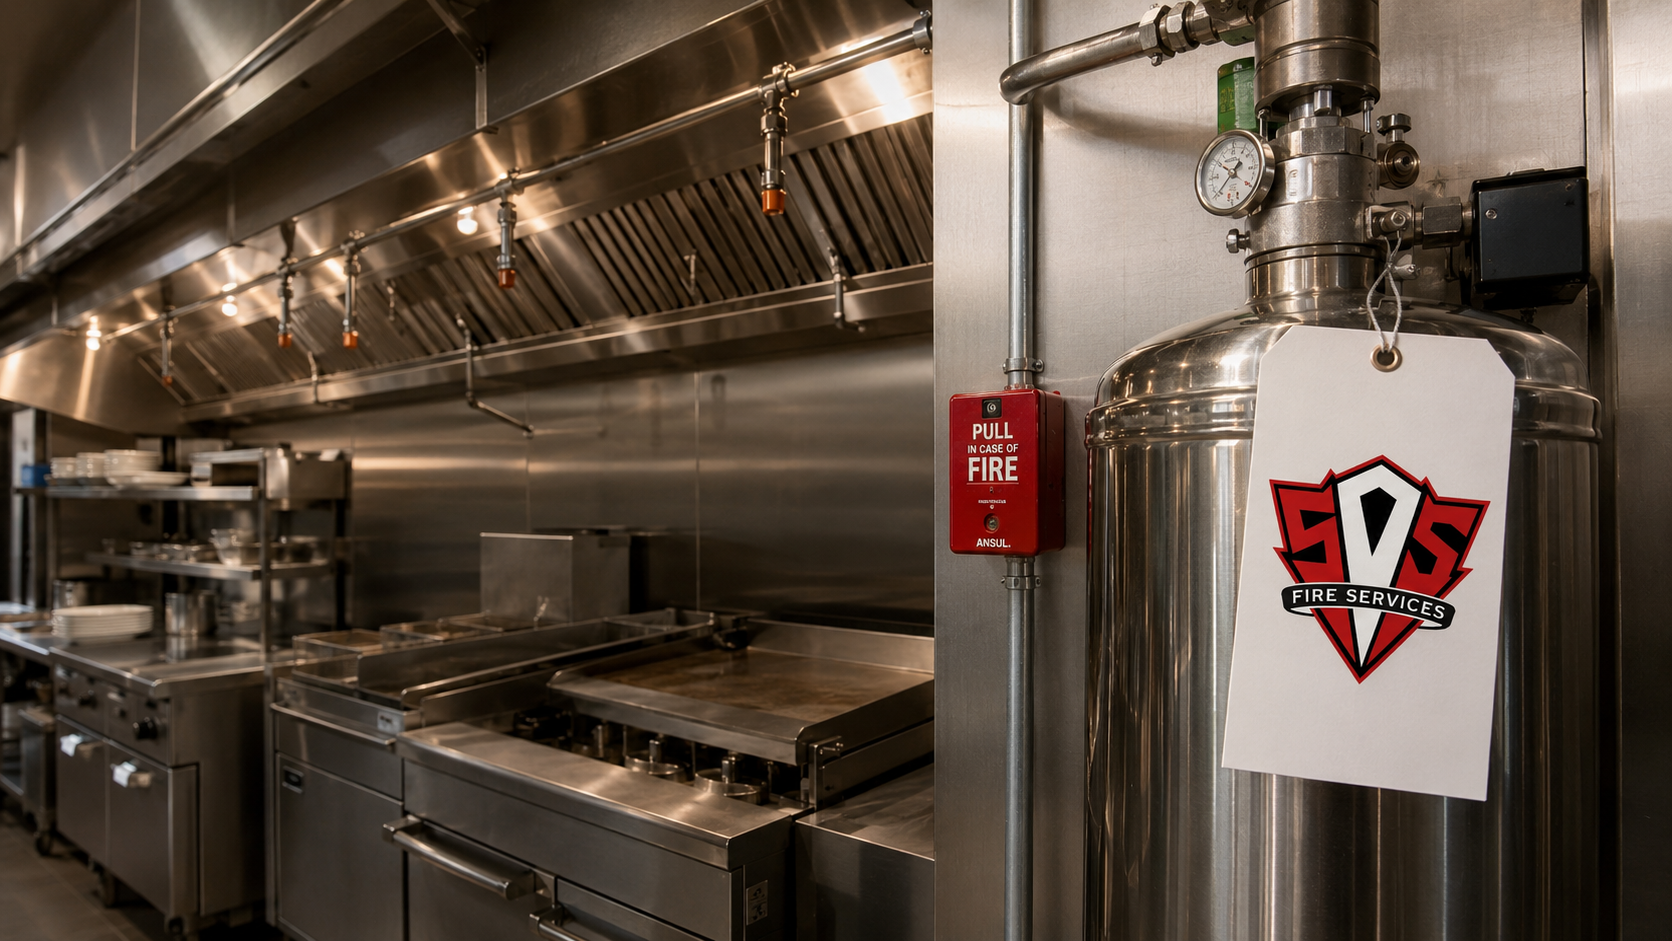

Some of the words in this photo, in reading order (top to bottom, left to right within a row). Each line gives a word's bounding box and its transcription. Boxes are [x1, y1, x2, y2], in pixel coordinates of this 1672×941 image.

[972, 422, 1013, 440] PULL
[967, 445, 977, 454] IN
[979, 444, 1003, 454] CASE
[1006, 443, 1019, 453] OF
[968, 456, 1018, 482] FIRE
[1292, 588, 1337, 604] FIRE
[1346, 588, 1446, 620] SERVICES
